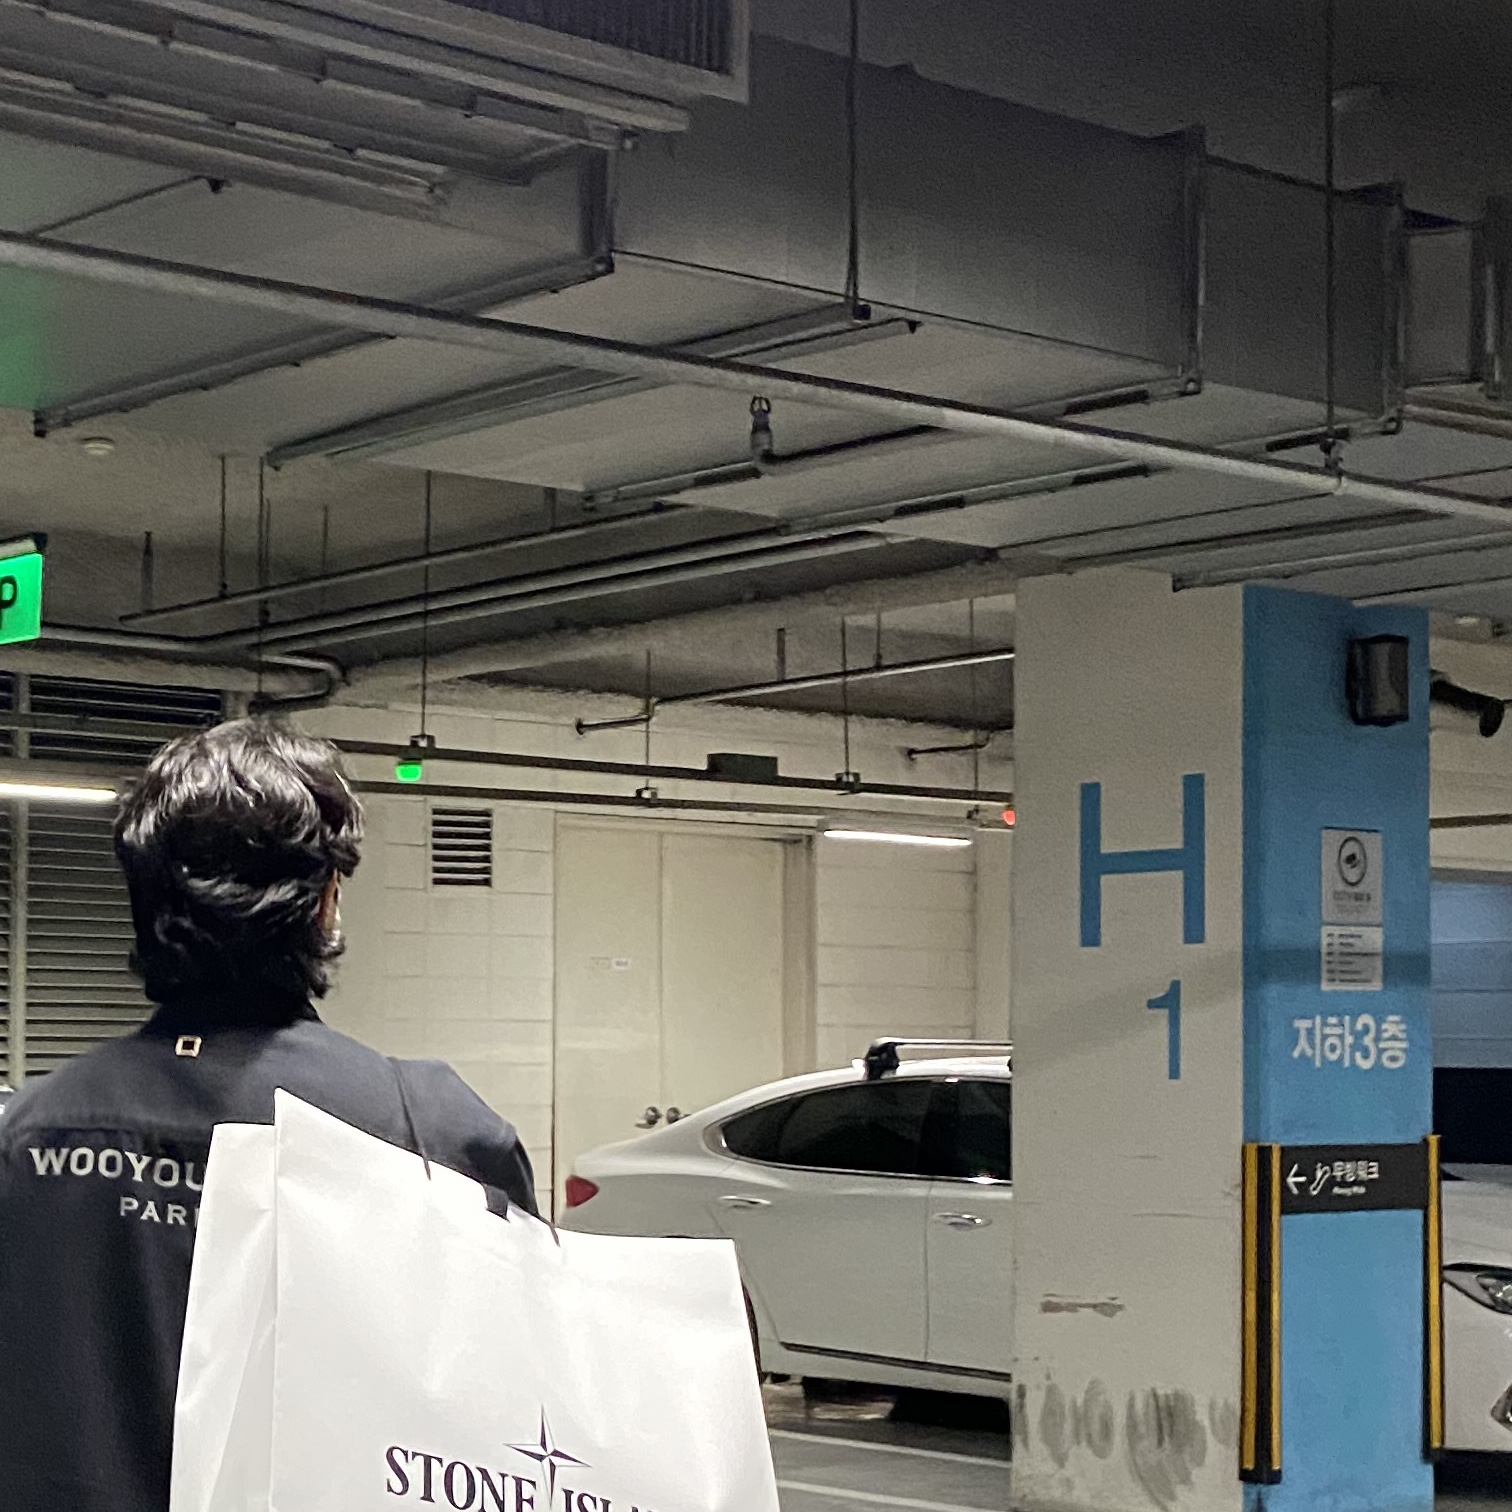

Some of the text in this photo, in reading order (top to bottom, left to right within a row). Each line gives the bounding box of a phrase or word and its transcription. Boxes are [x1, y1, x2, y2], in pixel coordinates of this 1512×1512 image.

[1079, 772, 1205, 947] H
[1146, 979, 1181, 1080] 1
[1292, 1013, 1408, 1070] 지하3층
